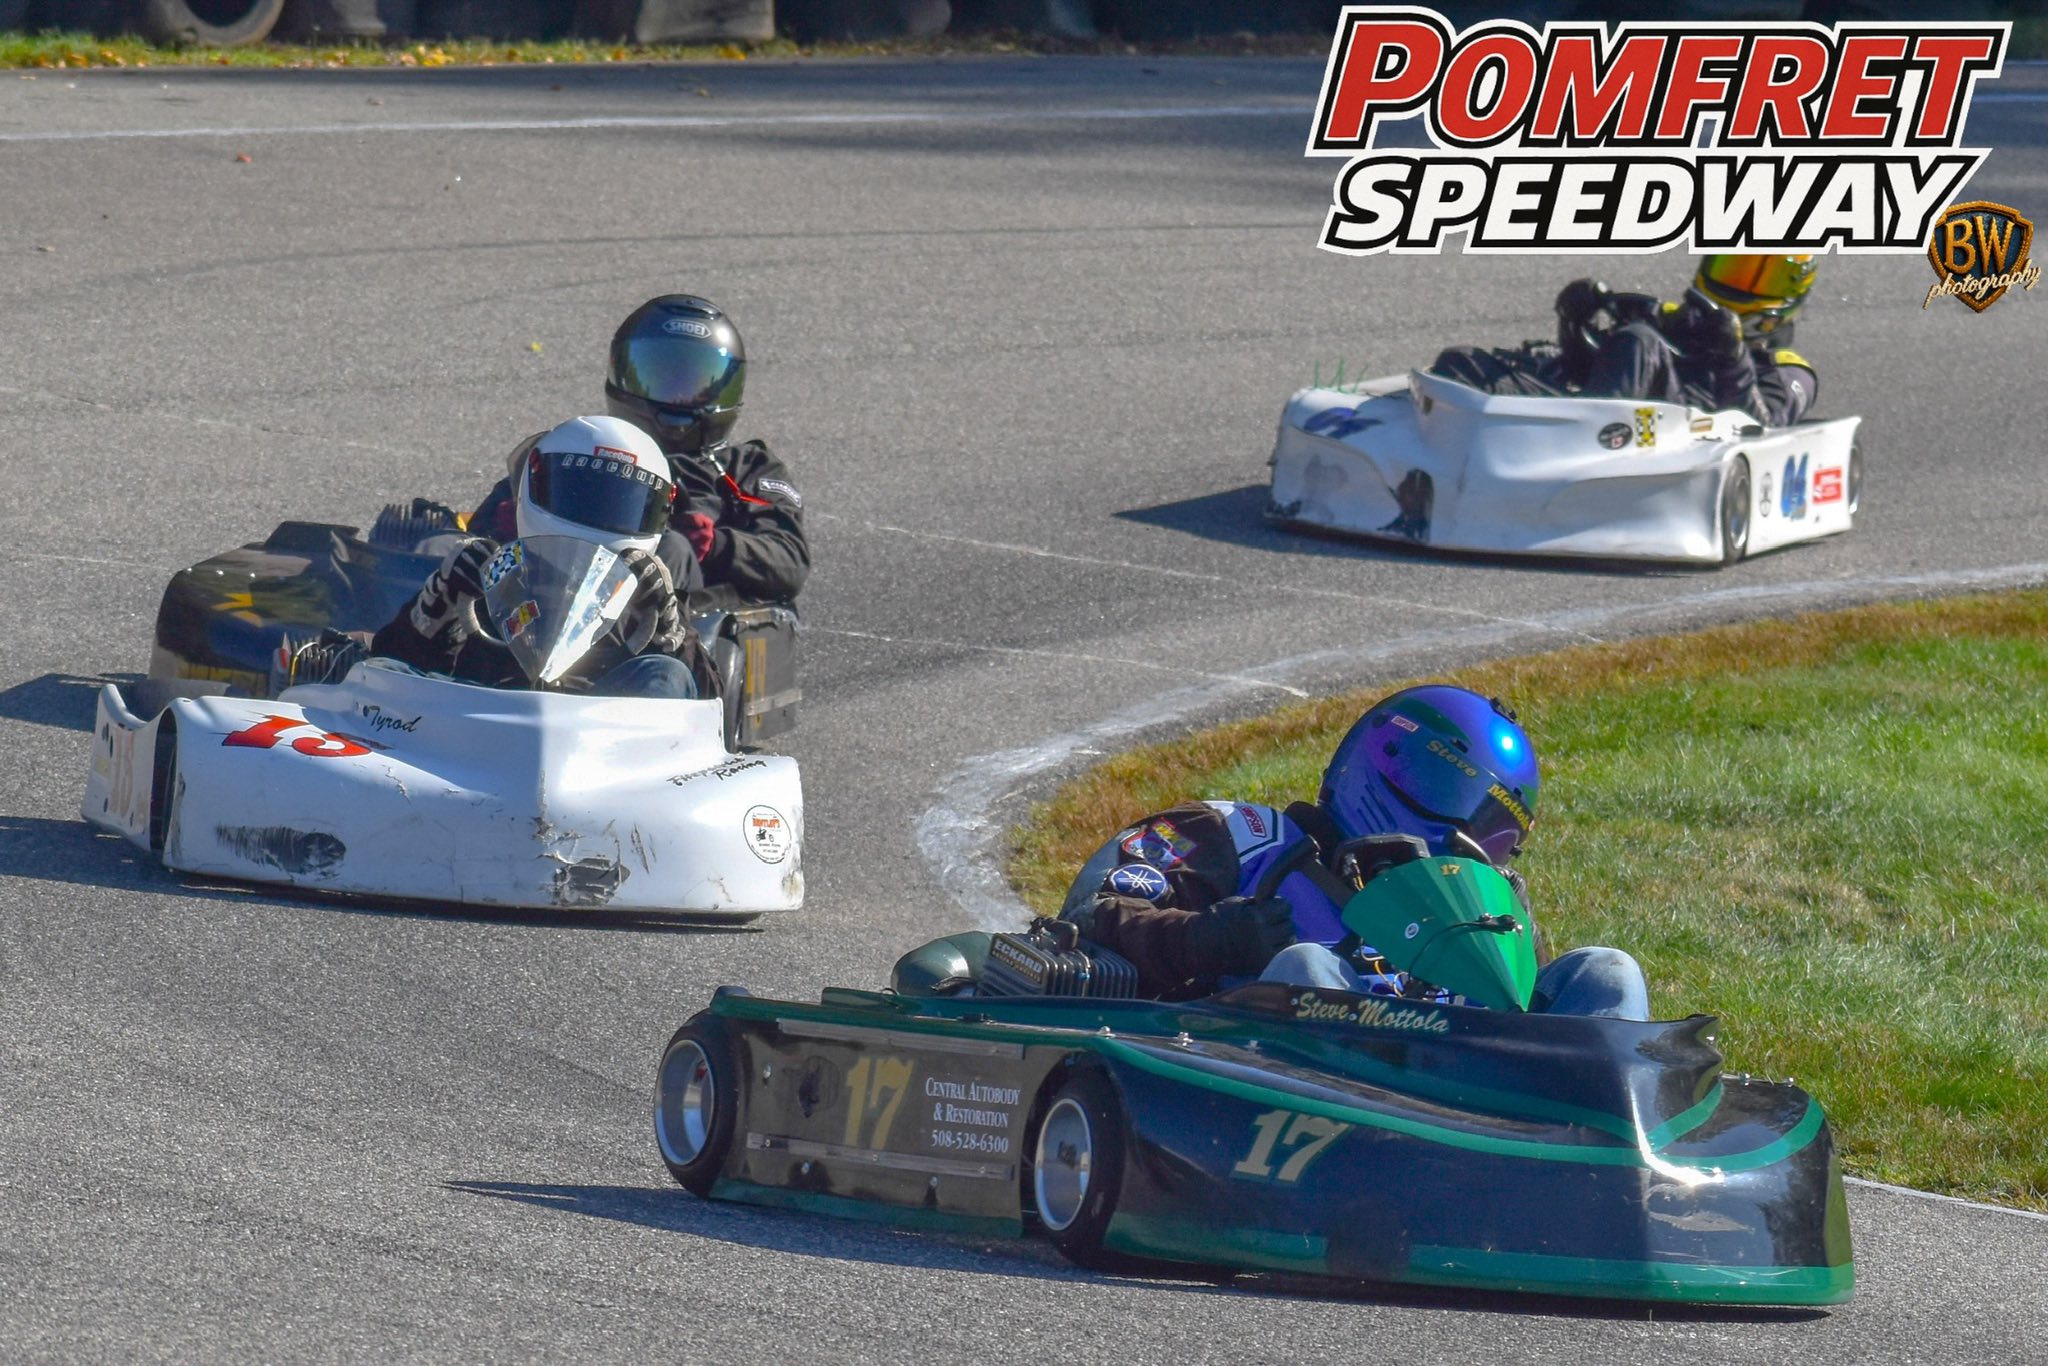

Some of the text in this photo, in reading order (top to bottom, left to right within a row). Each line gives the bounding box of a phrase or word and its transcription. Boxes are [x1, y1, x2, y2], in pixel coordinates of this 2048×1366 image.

[669, 321, 706, 337] SHOEI
[1426, 740, 1477, 777] Steve
[1440, 864, 1462, 876] 17
[1296, 992, 1450, 1034] Steve Mottola
[845, 1055, 915, 1150] 17
[934, 1102, 943, 1122] &
[931, 1130, 1009, 1153] 508-528-6300
[1234, 1109, 1350, 1183] 17
